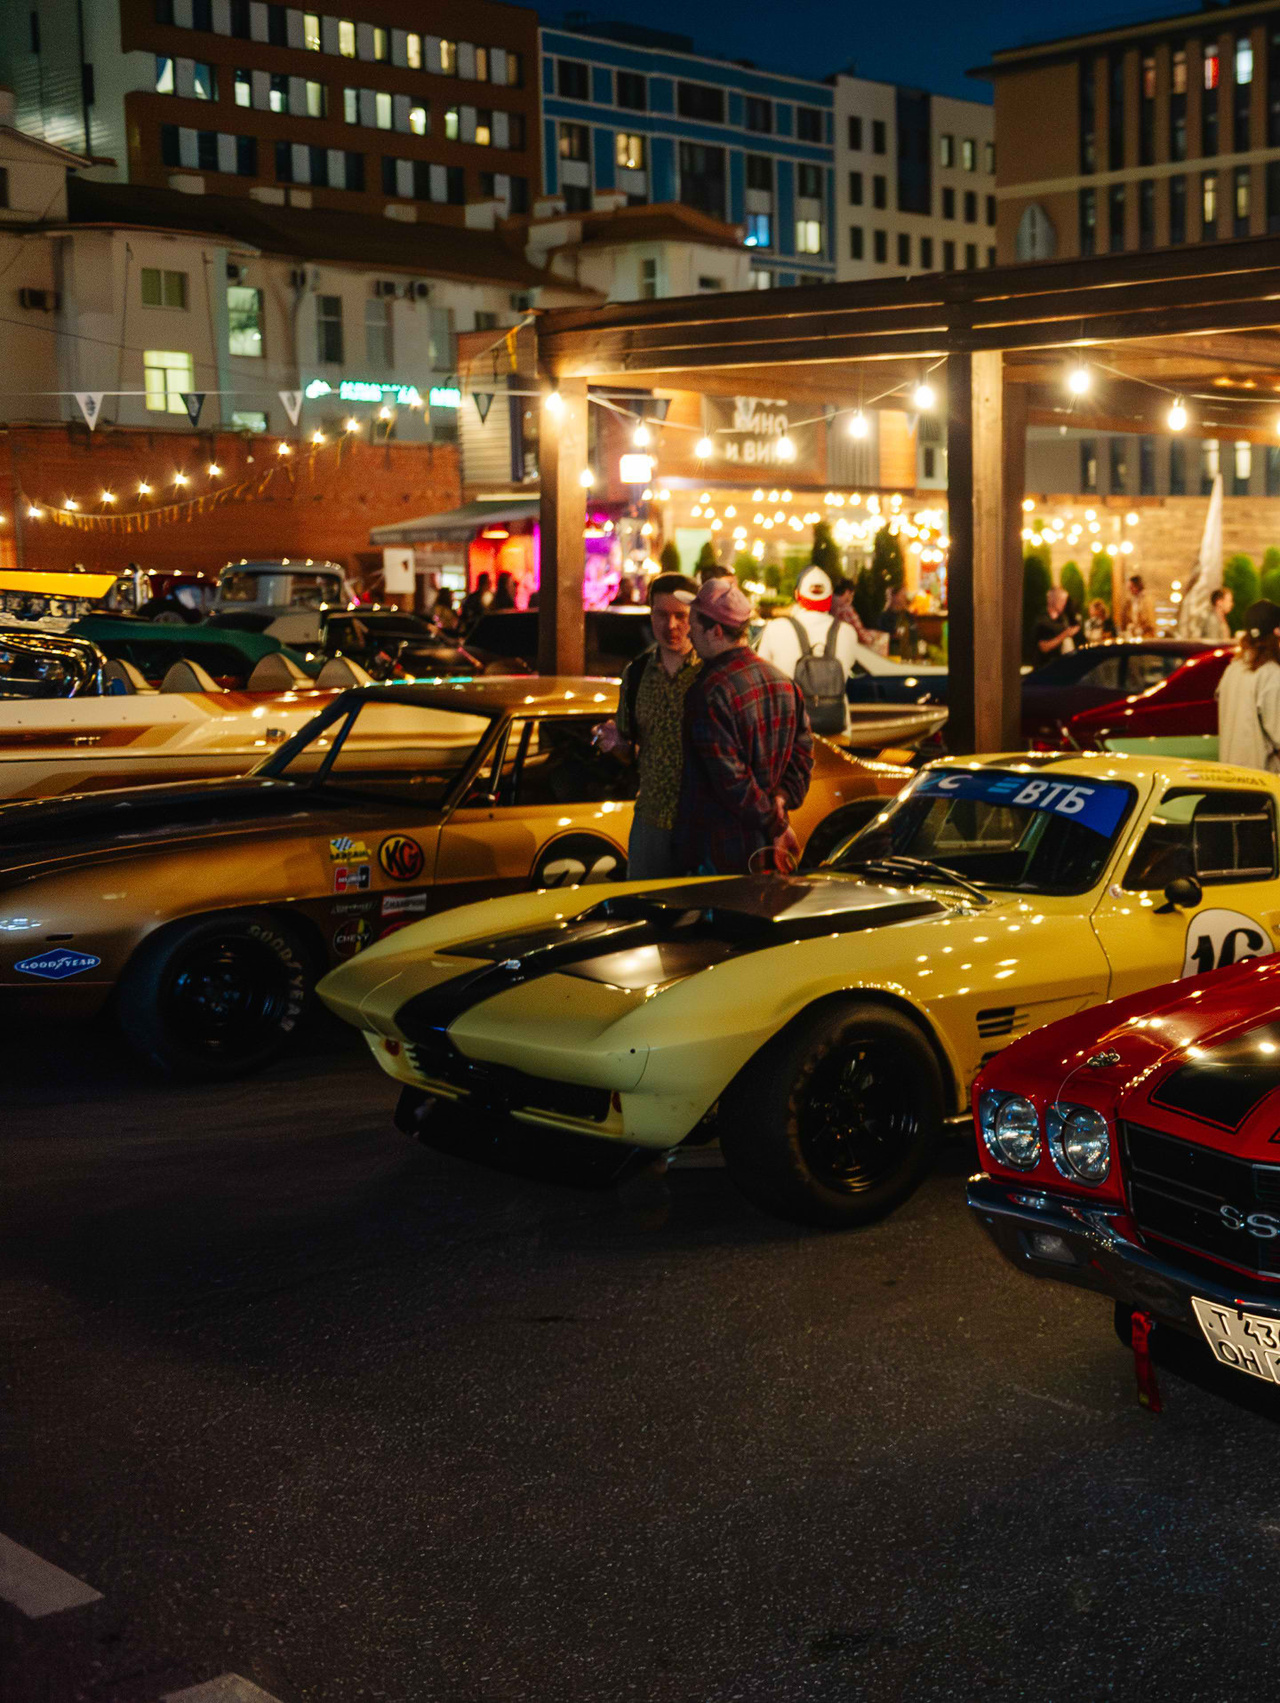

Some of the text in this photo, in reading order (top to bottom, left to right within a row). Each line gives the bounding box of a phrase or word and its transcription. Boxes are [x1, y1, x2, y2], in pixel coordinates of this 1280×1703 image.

[1012, 779, 1095, 814] ВТБ
[336, 933, 370, 943] CHEVY
[1211, 1309, 1231, 1336] Т
[1218, 1340, 1264, 1375] ОН
